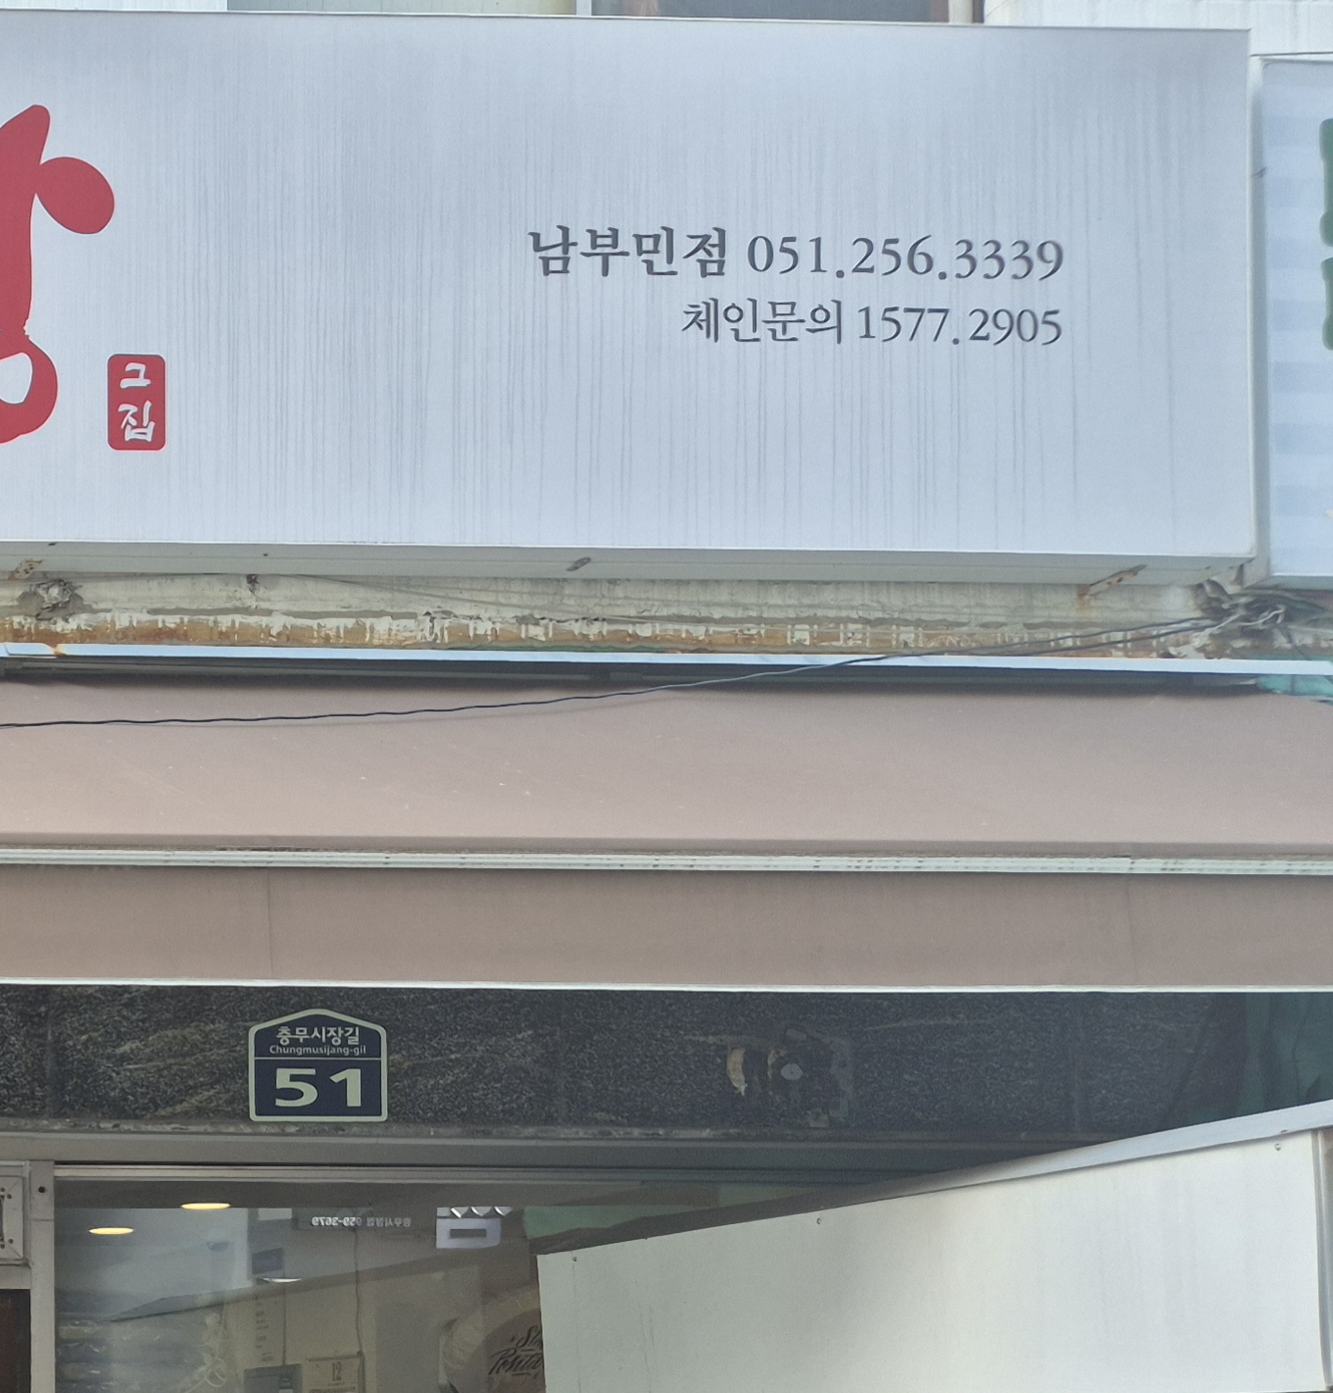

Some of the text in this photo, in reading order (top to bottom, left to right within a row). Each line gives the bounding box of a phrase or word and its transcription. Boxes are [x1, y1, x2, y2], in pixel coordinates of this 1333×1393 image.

[527, 226, 1065, 281] 남부민점 051.256.3339
[680, 297, 1064, 346] 체인문의 1577.2905
[269, 1044, 367, 1056] Chungmusijang-gil
[276, 1026, 361, 1046] 충무시장길
[274, 1067, 363, 1108] 51
